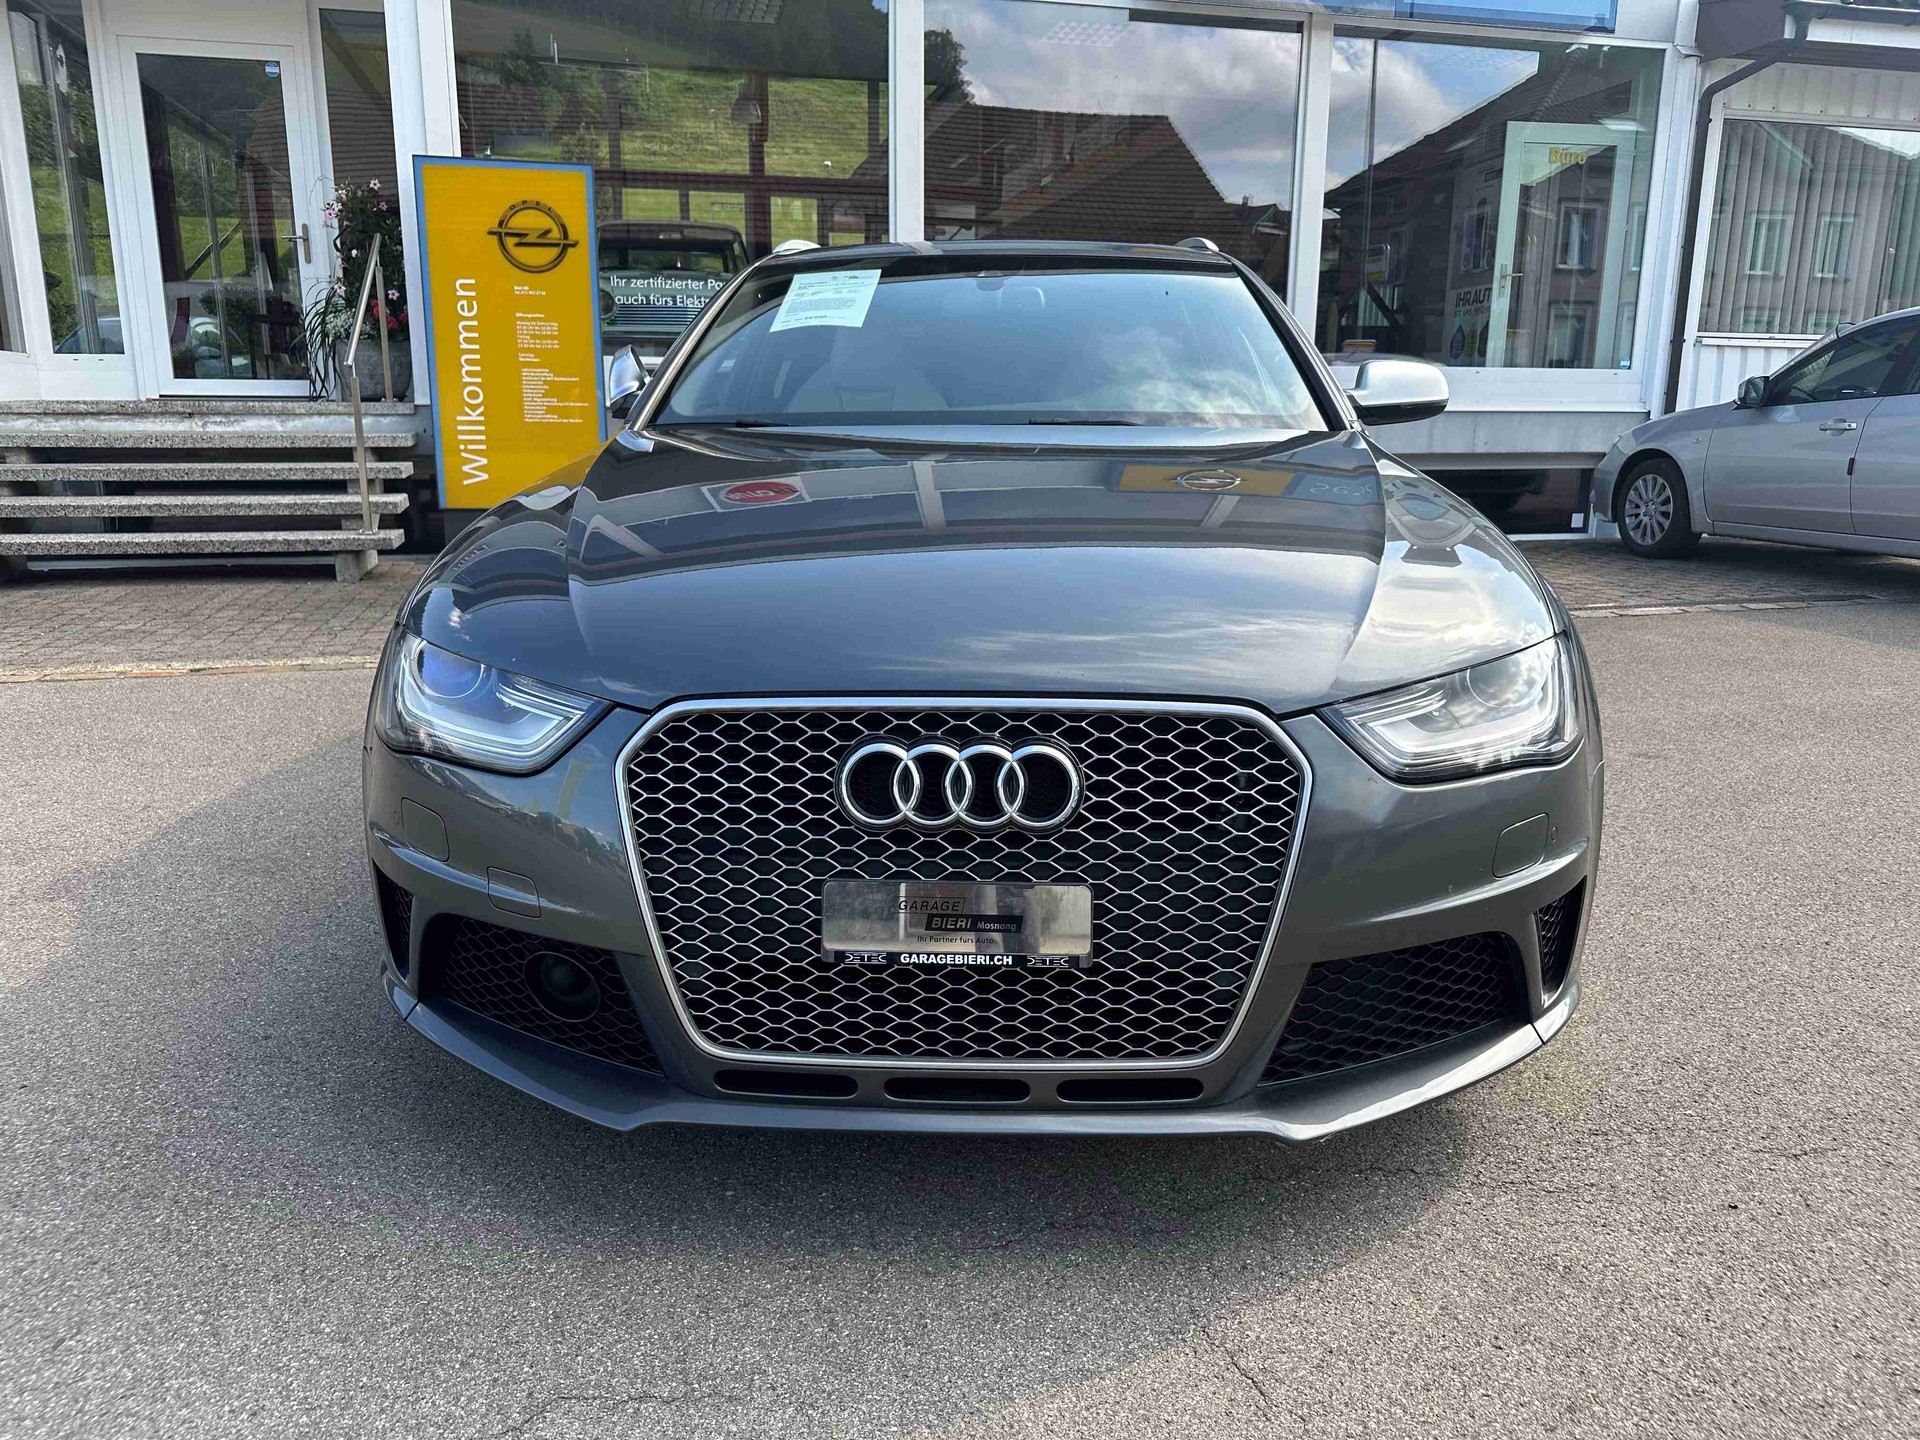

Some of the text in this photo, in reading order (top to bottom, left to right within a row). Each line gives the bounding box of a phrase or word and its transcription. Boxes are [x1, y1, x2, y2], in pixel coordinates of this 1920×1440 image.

[1549, 147, 1587, 165] Büro
[509, 199, 552, 213] OPEL
[610, 275, 726, 290] Ihr zertifizierter Pa
[615, 293, 646, 305] auch
[649, 293, 673, 305] fürs
[1455, 291, 1471, 308] IHR
[455, 277, 489, 485] Willkommen
[898, 900, 961, 912] GARAGE
[931, 917, 1017, 932] BIERI Mosnang
[929, 935, 957, 943] Partner
[900, 954, 1013, 965] GARAGEBIERI.CH
